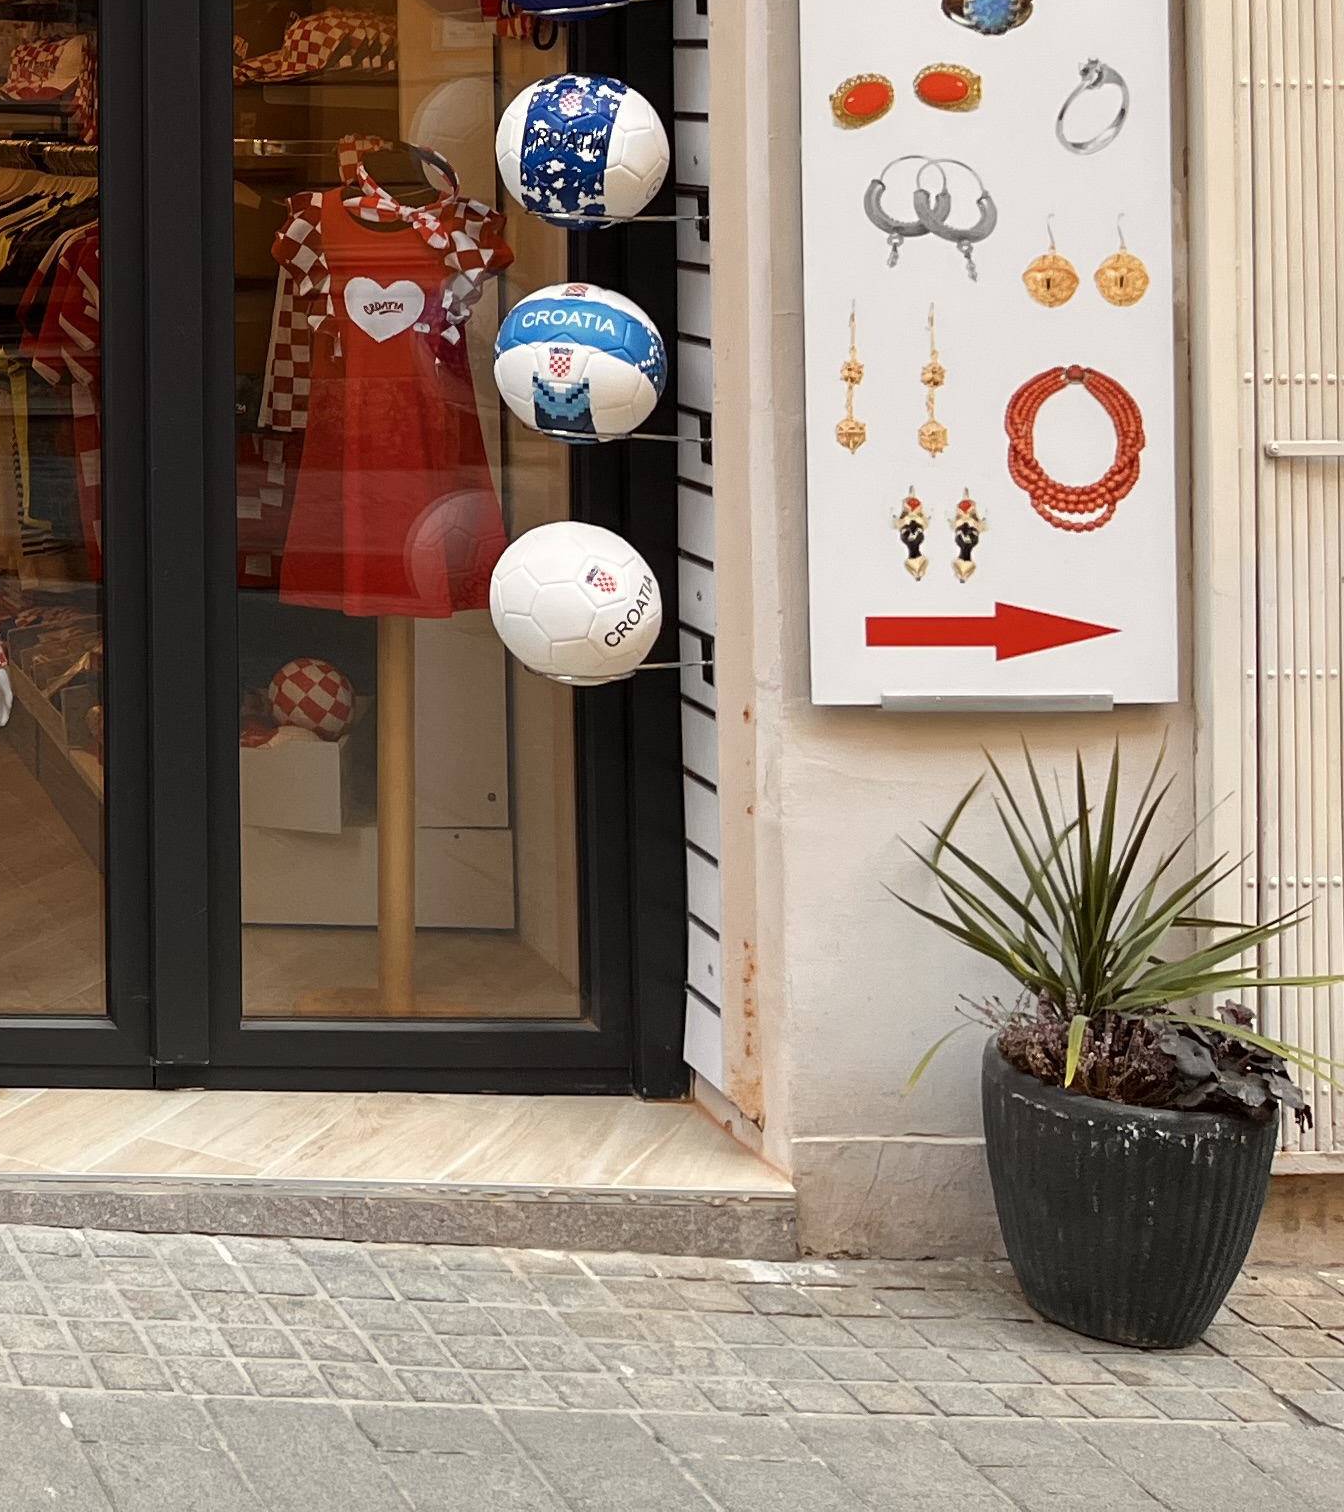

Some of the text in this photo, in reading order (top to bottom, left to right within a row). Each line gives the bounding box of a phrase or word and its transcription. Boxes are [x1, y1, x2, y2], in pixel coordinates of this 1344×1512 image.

[524, 126, 608, 155] CROATIA
[363, 301, 404, 316] CROATIA
[522, 309, 617, 337] CROATIA
[602, 573, 656, 650] CROATIA
